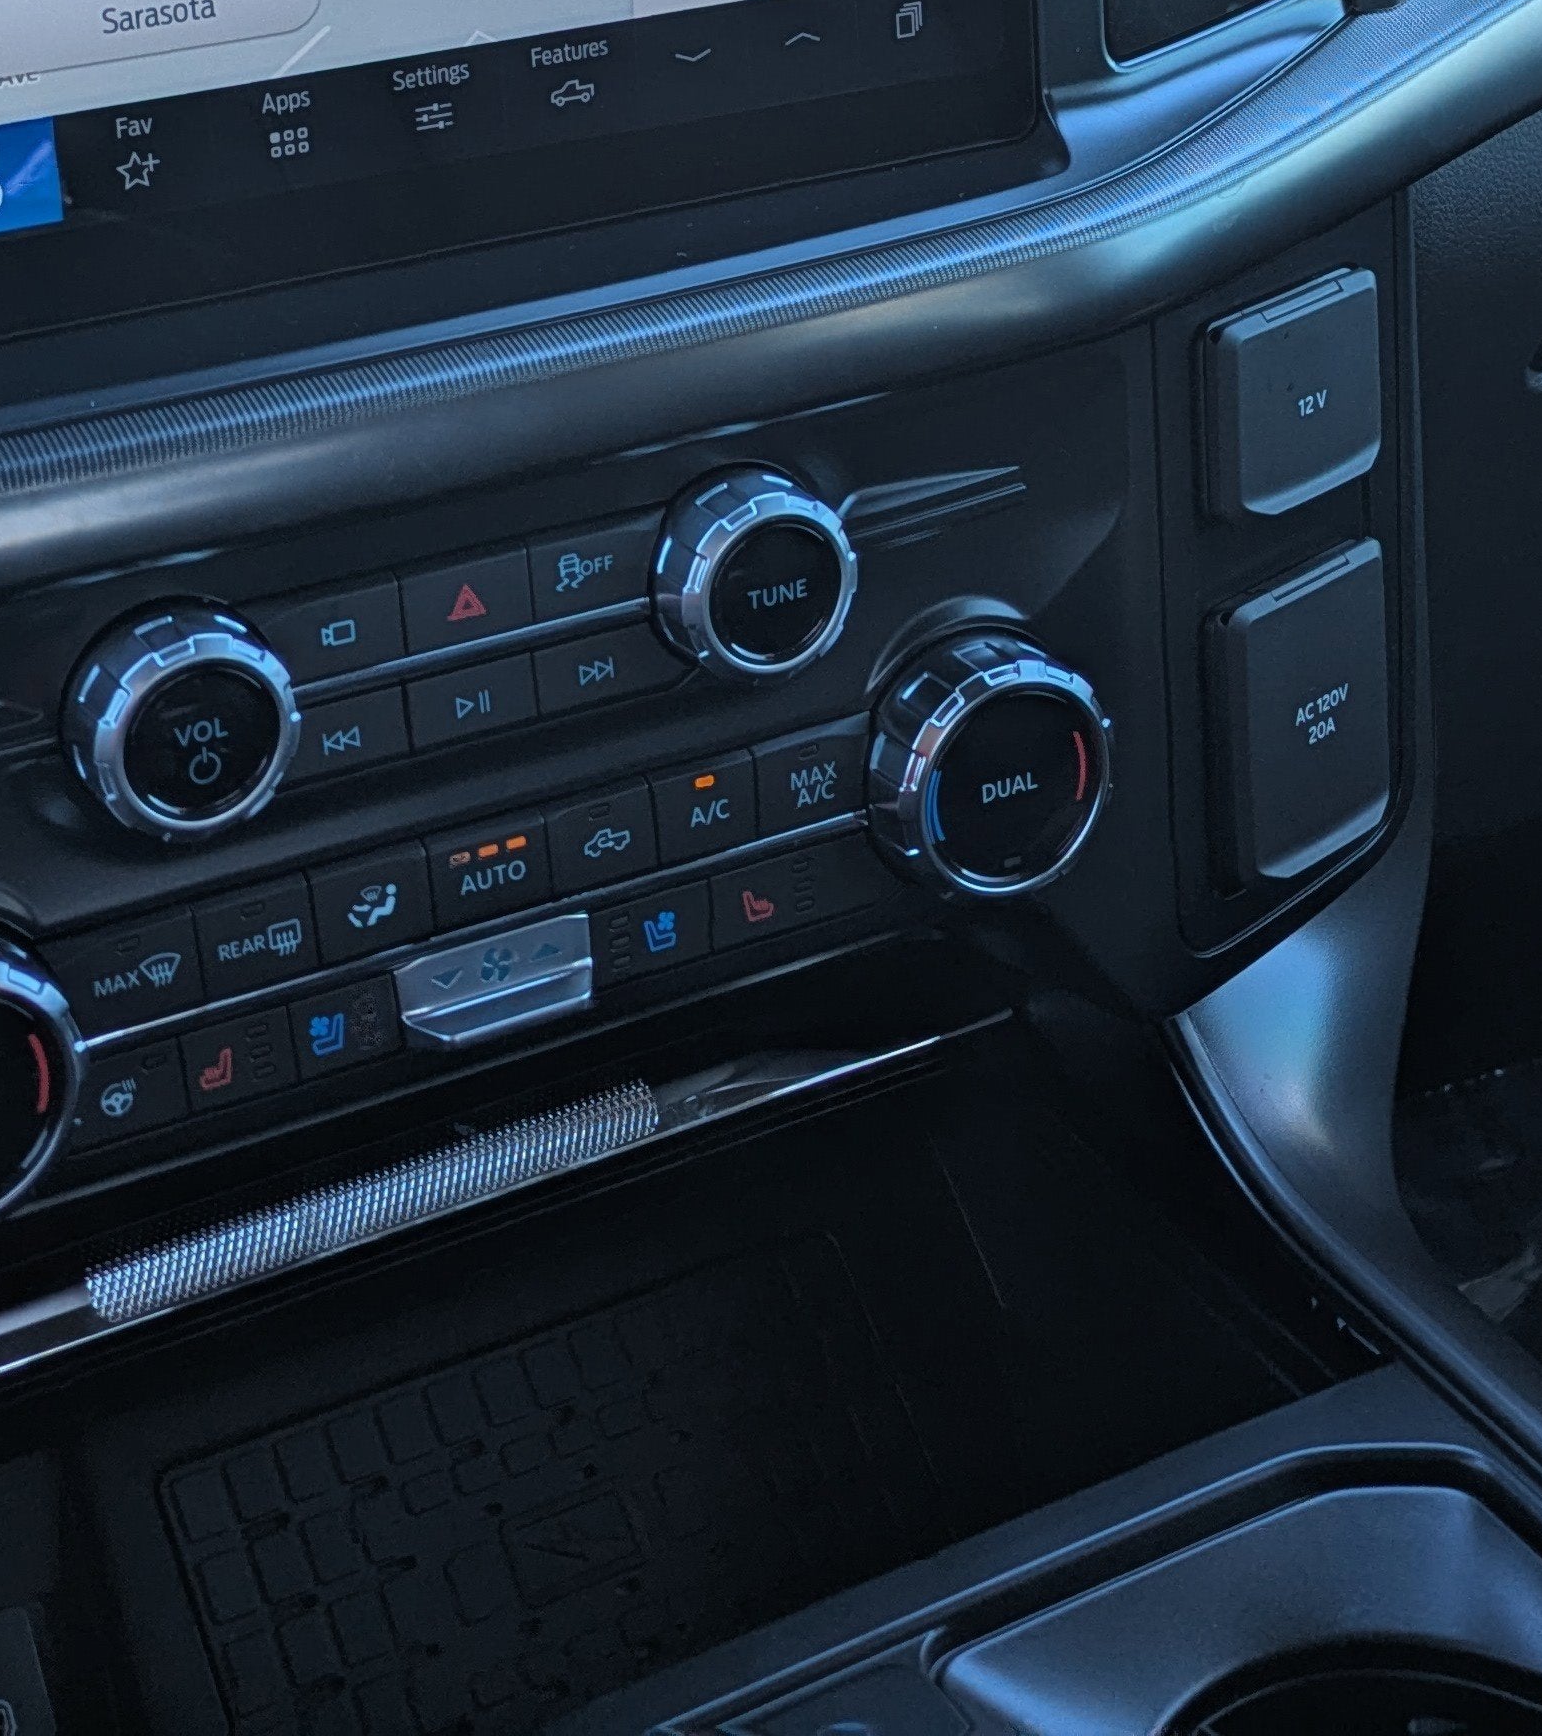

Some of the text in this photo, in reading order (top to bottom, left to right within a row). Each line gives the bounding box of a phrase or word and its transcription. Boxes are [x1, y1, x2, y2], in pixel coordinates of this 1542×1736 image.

[530, 37, 608, 68] Features
[392, 62, 470, 92] Settings
[261, 90, 311, 117] Apps
[115, 117, 153, 139] Fav
[579, 554, 614, 578] OFF
[747, 578, 808, 610] TUNE
[1295, 682, 1350, 726] AC 120V
[173, 718, 229, 748] VOL
[1308, 716, 1337, 746] 20A
[790, 761, 838, 791] MAX
[981, 772, 1039, 805] DUAL
[796, 782, 835, 809] A/C
[690, 799, 730, 828] A/C
[460, 860, 527, 896] AUTO
[217, 935, 265, 962] REAR
[93, 972, 141, 999] MAX
